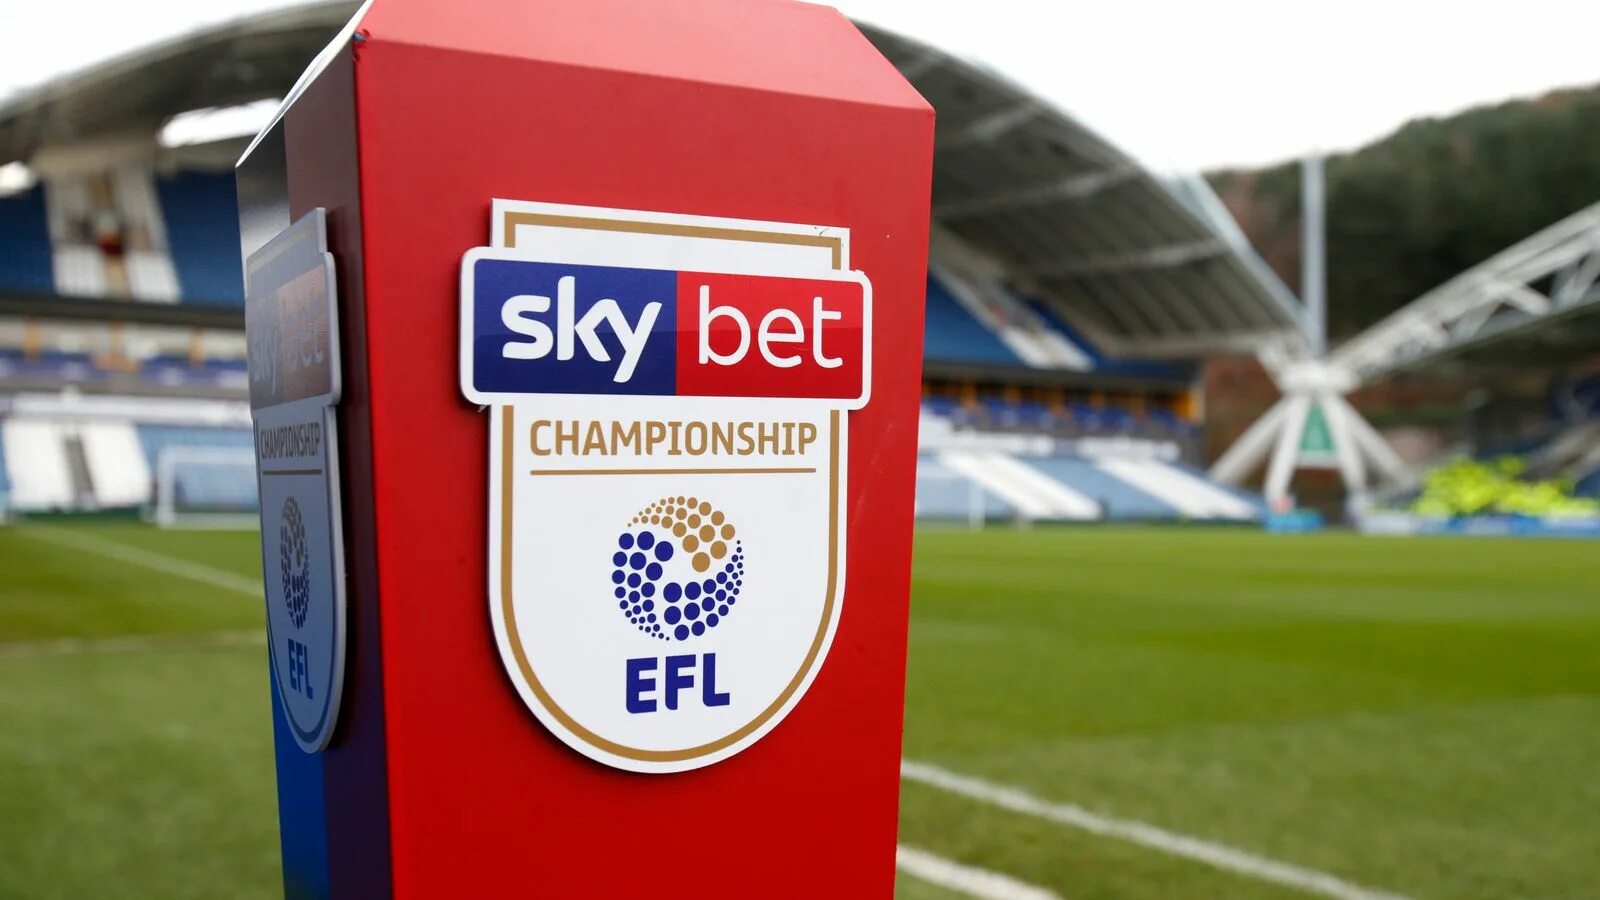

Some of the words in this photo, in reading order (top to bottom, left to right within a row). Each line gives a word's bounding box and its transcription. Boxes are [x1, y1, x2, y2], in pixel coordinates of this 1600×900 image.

[501, 276, 662, 383] sky
[699, 285, 843, 368] bet
[260, 422, 320, 460] CHAMPIONSHIP
[530, 419, 817, 456] CHAMPIONSHIP
[288, 638, 313, 700] EFL
[626, 652, 730, 714] EFL
